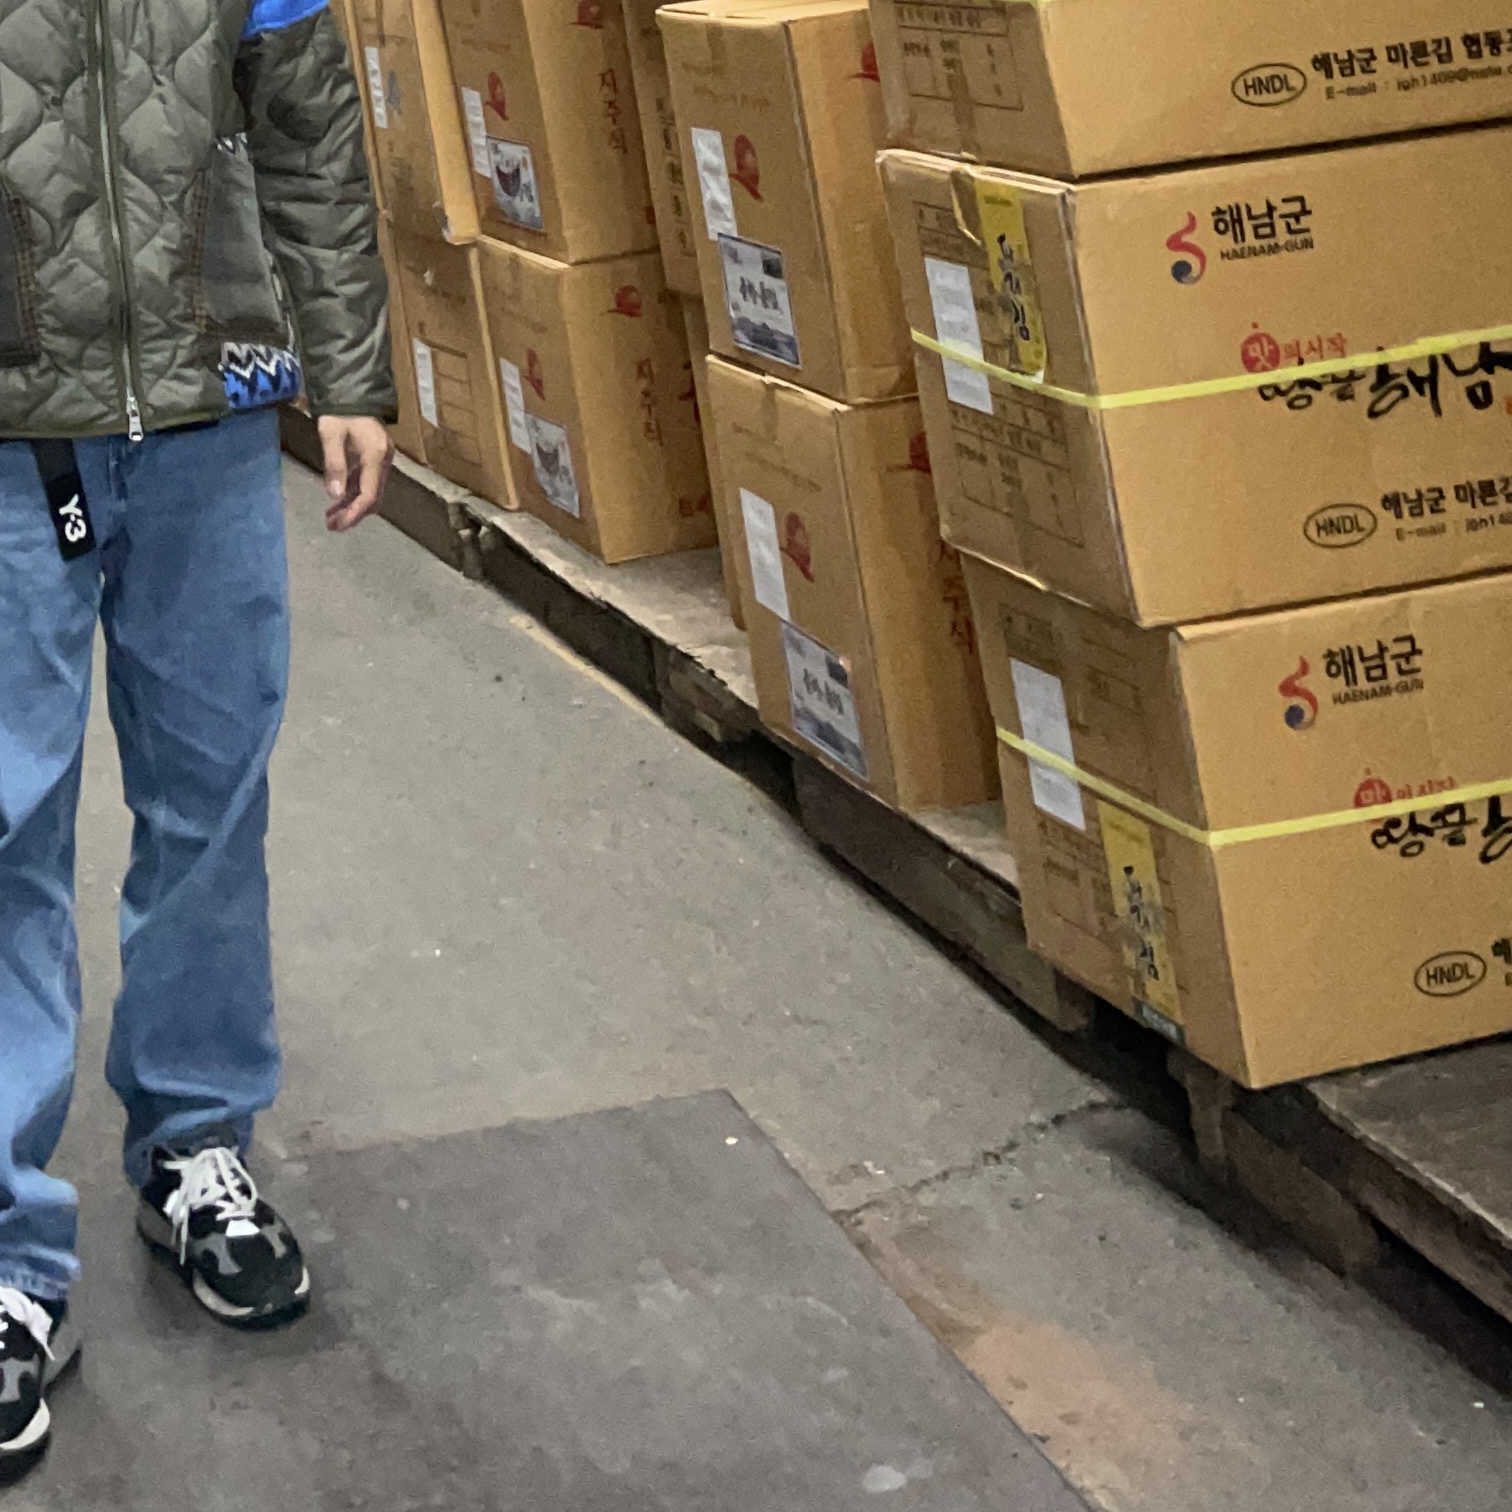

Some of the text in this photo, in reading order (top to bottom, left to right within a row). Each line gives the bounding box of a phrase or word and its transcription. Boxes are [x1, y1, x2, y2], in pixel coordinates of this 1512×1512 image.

[1310, 29, 1512, 80] 해남군 마른김 협동
[1243, 73, 1297, 99] HNDL
[1210, 194, 1313, 245] 해남군
[1219, 236, 1315, 262] HAENAM-GUN
[59, 493, 87, 542] Y-3
[1380, 486, 1447, 520] 해남군
[1314, 513, 1367, 539] HNDL
[1322, 633, 1424, 687] 해남군
[1331, 677, 1425, 706] HAENAM-GUN
[1424, 962, 1476, 988] HNDL
